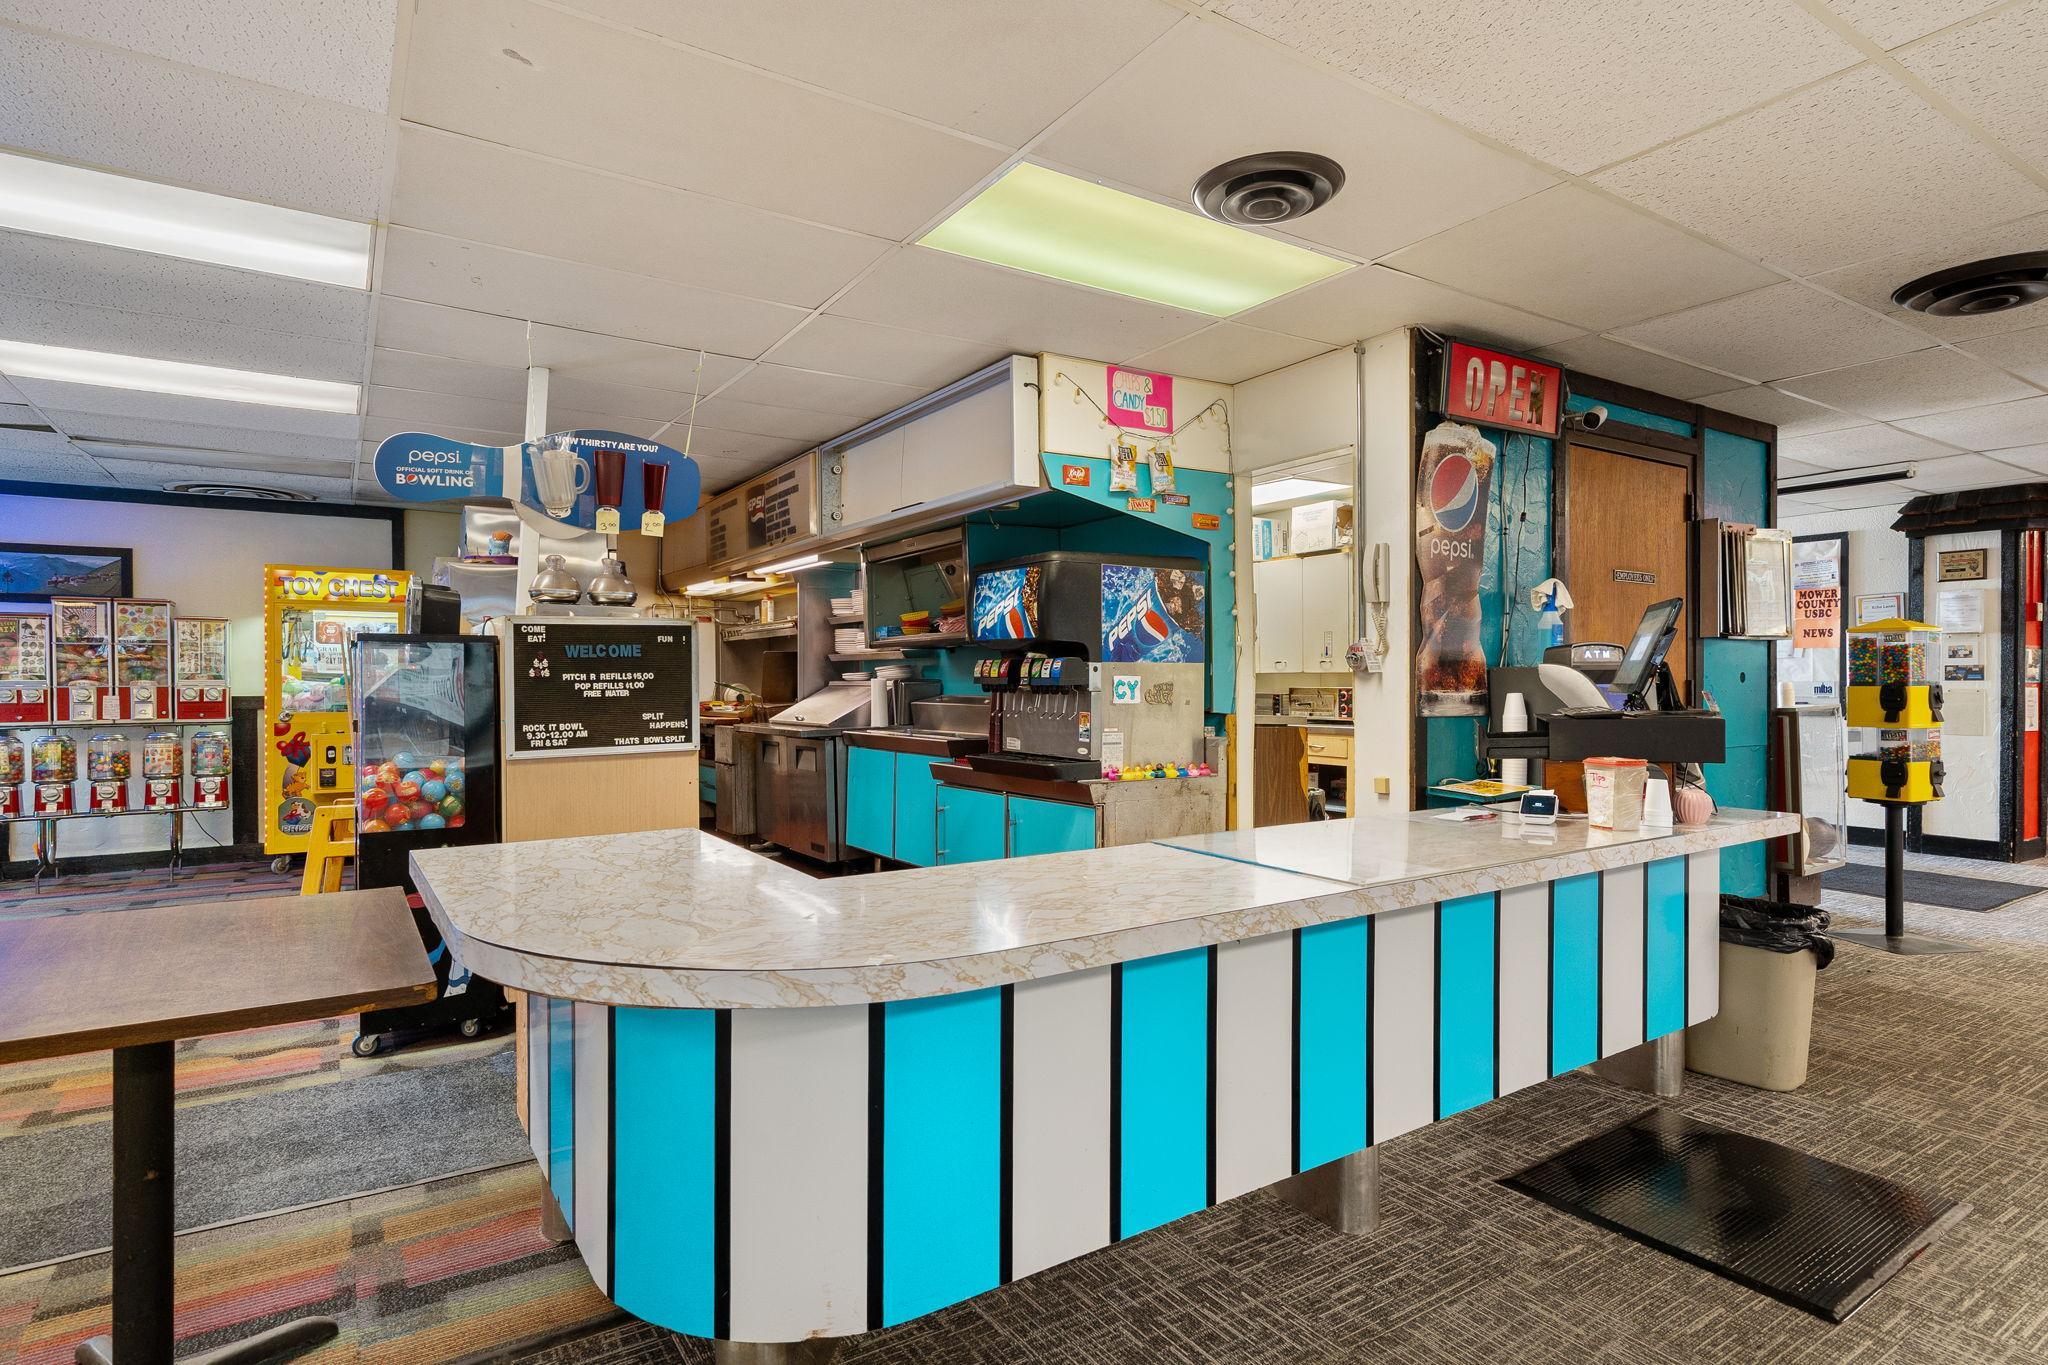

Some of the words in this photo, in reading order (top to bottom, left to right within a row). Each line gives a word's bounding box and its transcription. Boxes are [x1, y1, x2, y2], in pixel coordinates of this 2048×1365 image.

[1113, 370, 1141, 391] CHIPS
[1143, 377, 1152, 393] &
[1465, 356, 1546, 426] OPEN
[1113, 389, 1145, 410] CANDY
[580, 438, 617, 449] THIRSTY
[617, 442, 636, 451] ARE
[636, 444, 659, 453] YOU?
[408, 449, 461, 465] pepsi
[1431, 538, 1472, 561] pepsi
[279, 576, 322, 595] TOY
[328, 579, 399, 598] CHEST
[1799, 588, 1838, 600] MOWER
[1796, 598, 1840, 609] COUNTY
[977, 586, 1020, 638] PEPSI
[1804, 609, 1832, 618] USBC
[1108, 588, 1152, 652] PEPSI
[521, 625, 546, 633] COME
[1803, 628, 1834, 638] NEWS
[527, 633, 546, 642] EAT!
[657, 635, 673, 643] FUN
[565, 644, 642, 658] WELCOME
[1584, 650, 1610, 659] ATM
[562, 673, 587, 681] PITCH
[590, 673, 596, 681] R
[600, 672, 632, 680] REFILLS
[593, 682, 624, 690] REFILLS
[1114, 679, 1138, 700] CY
[642, 712, 664, 721] SPLIT
[523, 724, 545, 732] ROCK
[559, 722, 584, 731] BOWL
[650, 718, 688, 729] HAPPENS!
[575, 730, 588, 738] AM
[531, 740, 544, 748] FRI
[545, 739, 552, 747] &
[614, 737, 640, 746] THATS
[1589, 772, 1606, 785] Tips
